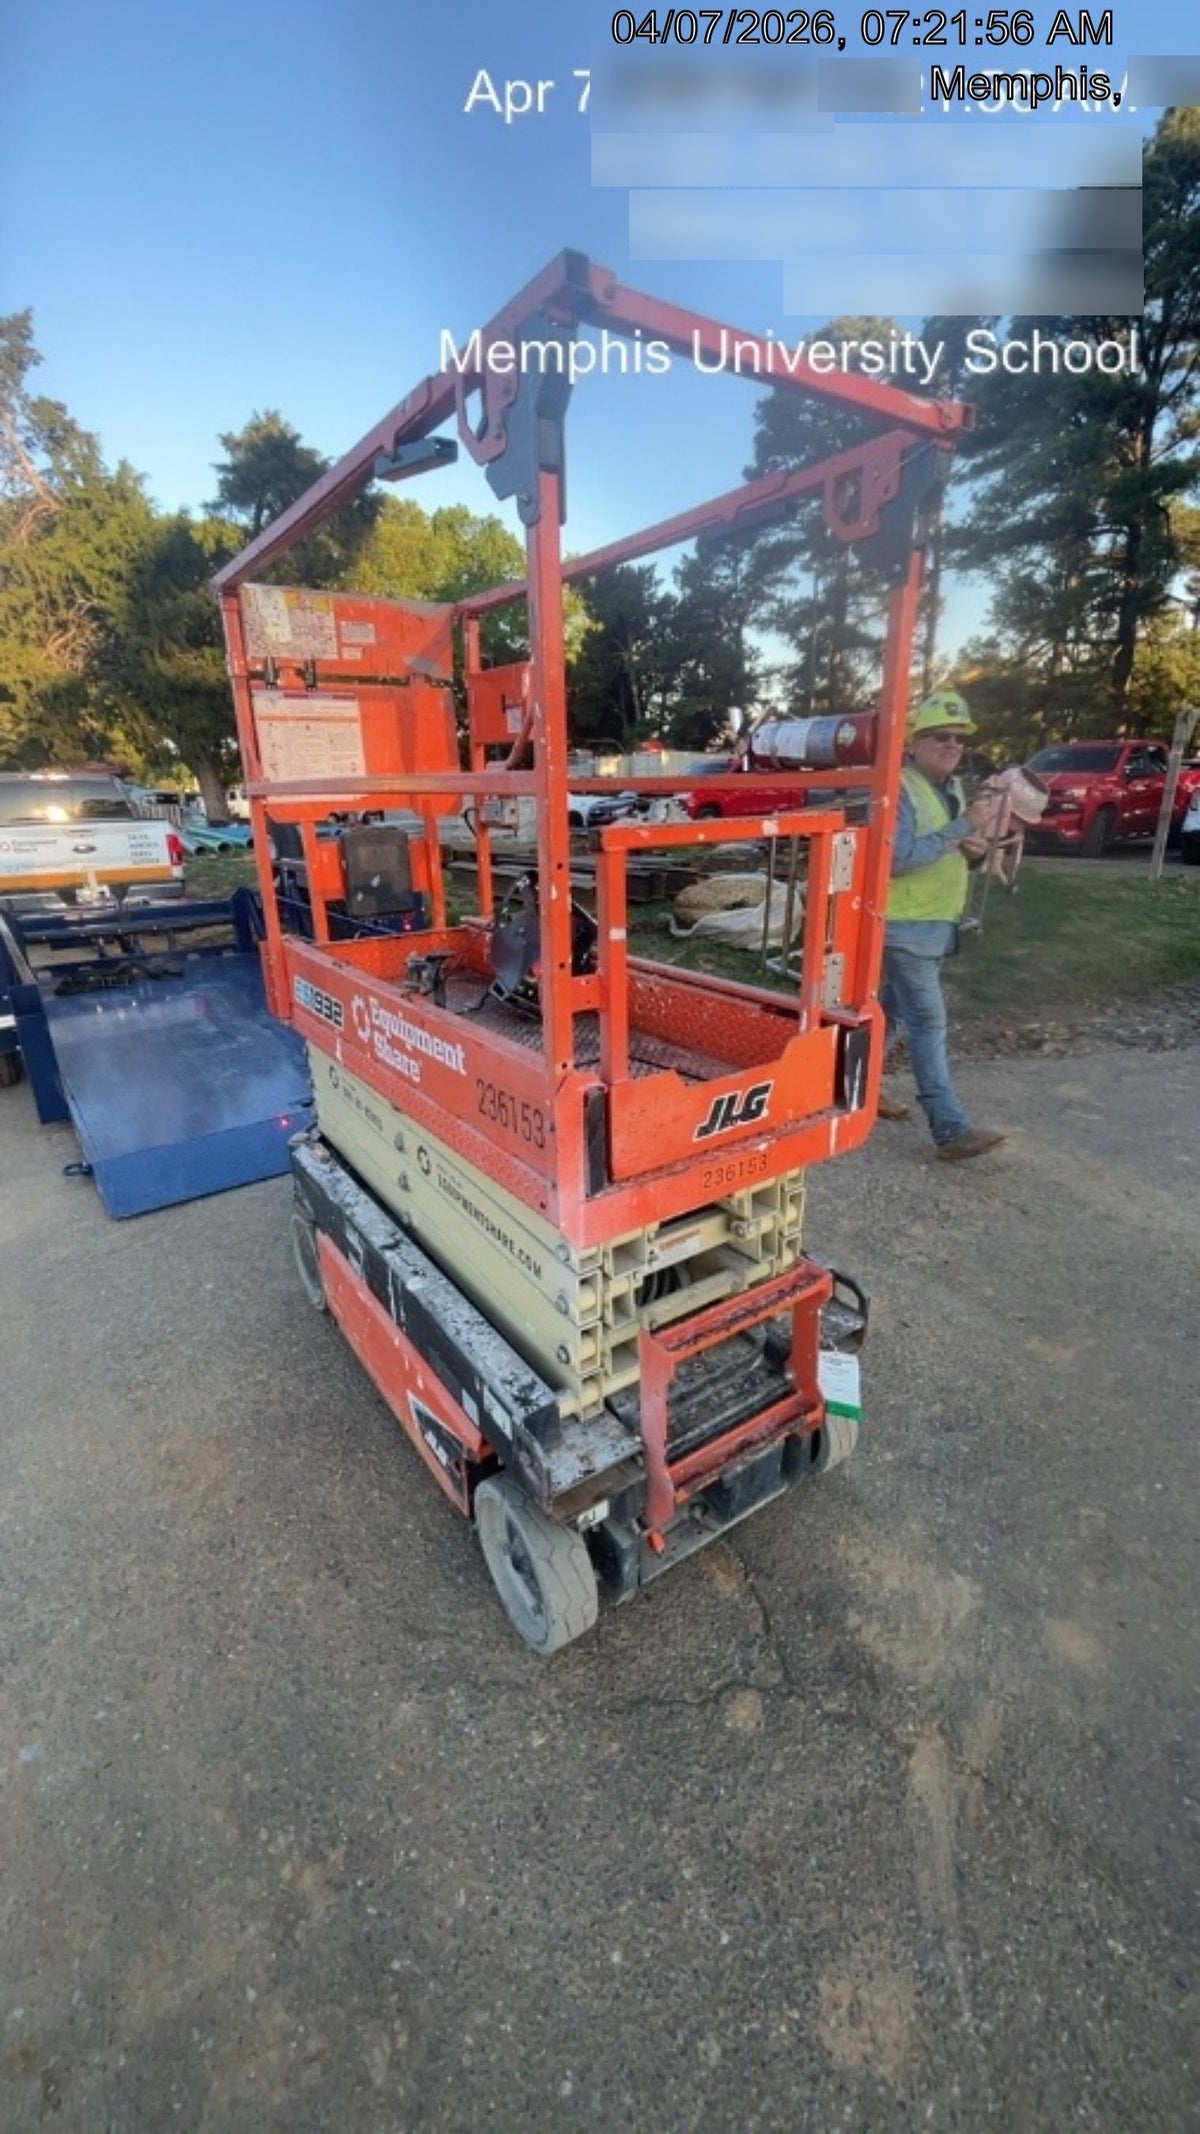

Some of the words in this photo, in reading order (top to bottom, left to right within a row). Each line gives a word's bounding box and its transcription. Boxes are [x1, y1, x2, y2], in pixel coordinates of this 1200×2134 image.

[369, 996, 467, 1077] Equipment
[374, 1030, 421, 1084] Share
[476, 1078, 547, 1150] 236153
[693, 1079, 774, 1142] JLG
[703, 1153, 768, 1190] 236153
